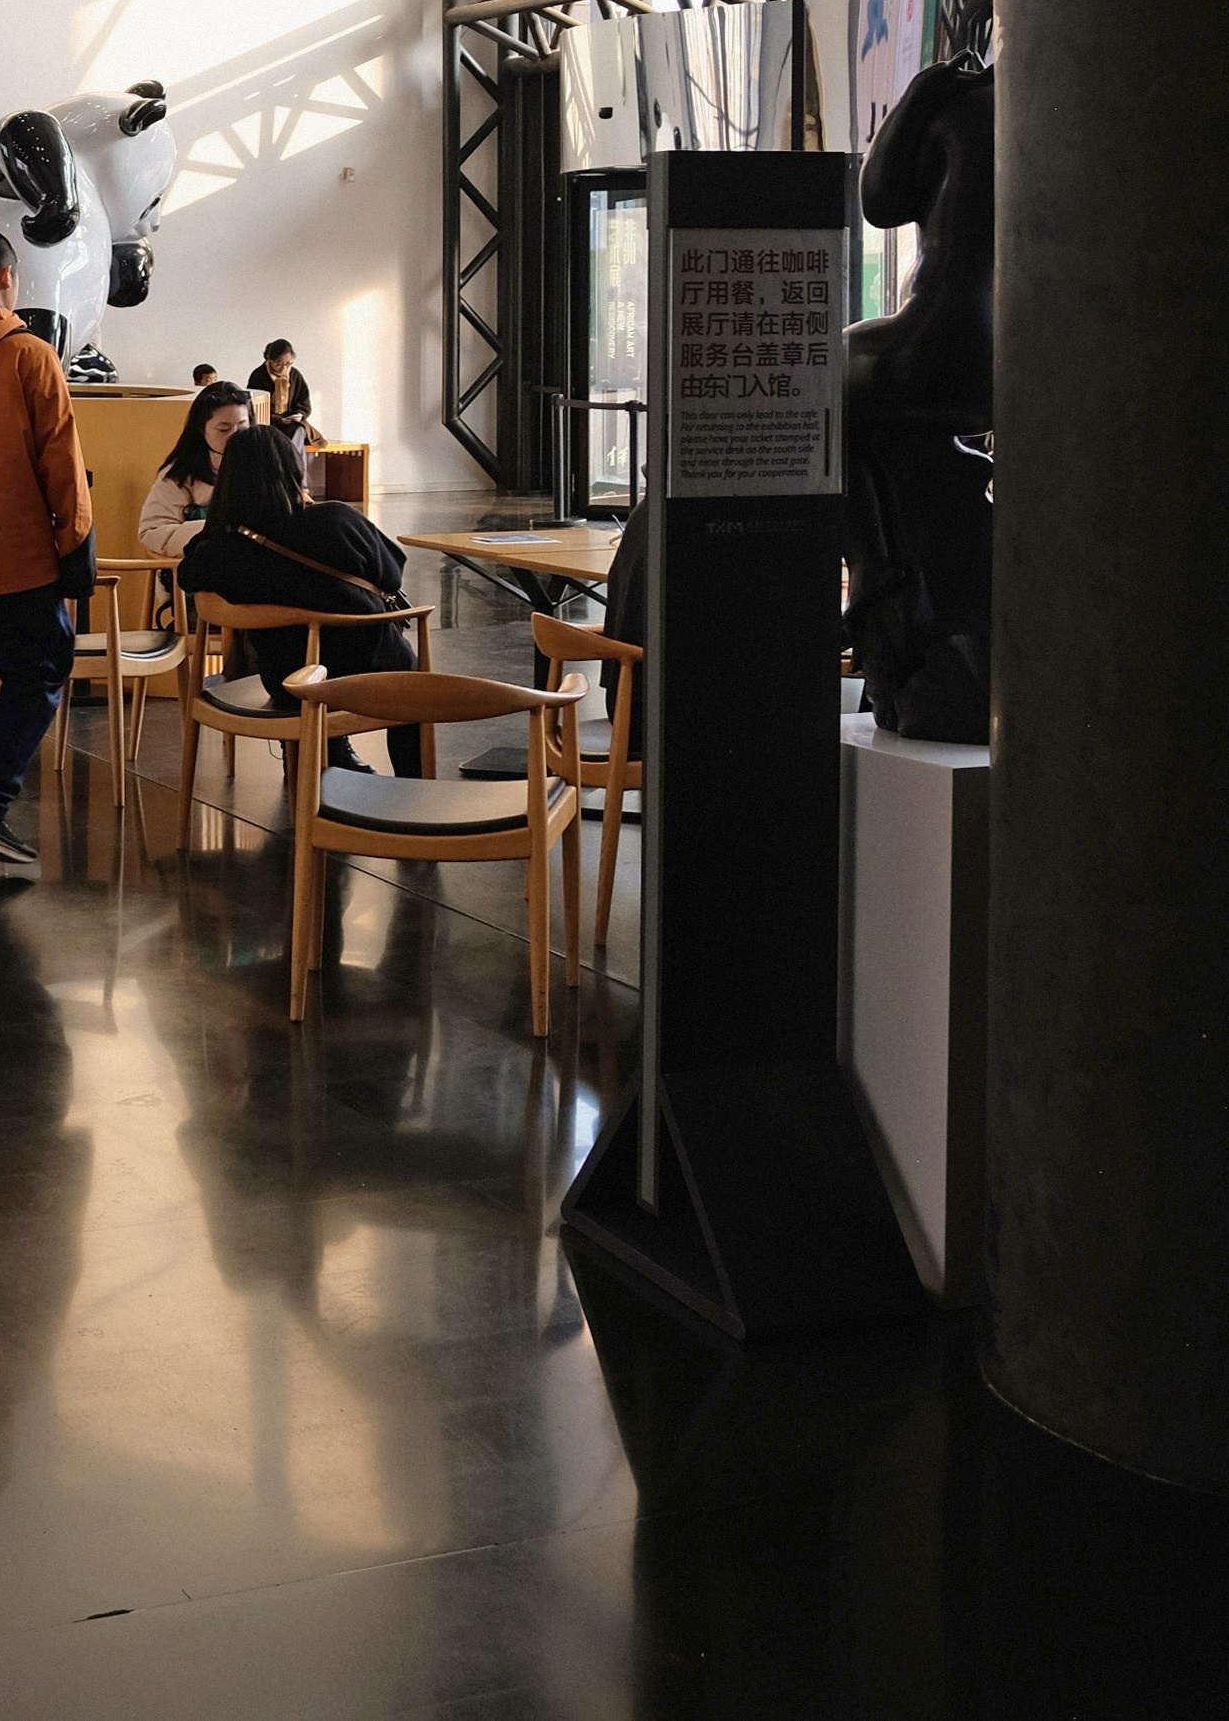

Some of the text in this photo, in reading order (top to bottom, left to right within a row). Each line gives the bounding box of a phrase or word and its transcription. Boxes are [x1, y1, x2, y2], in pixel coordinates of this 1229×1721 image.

[681, 249, 829, 274] 此门通往咖啡
[680, 281, 829, 306] 厅用餐，返回
[626, 301, 635, 358] AFRICAN ART
[680, 311, 829, 337] 展厅请在南侧
[680, 342, 829, 368] 服务台盖章后
[681, 373, 801, 399] 由东门入馆。
[737, 411, 754, 421] only
[785, 410, 799, 418] the
[746, 422, 760, 430] the
[680, 434, 708, 446] please
[730, 435, 749, 446] your
[725, 446, 744, 455] desk
[758, 446, 772, 454] the
[773, 445, 797, 454] south
[721, 457, 754, 468] through
[755, 457, 770, 466] the
[771, 457, 788, 465] east
[681, 470, 706, 479] Thank
[707, 471, 723, 480] you
[724, 469, 737, 480] for
[738, 470, 757, 480] your
